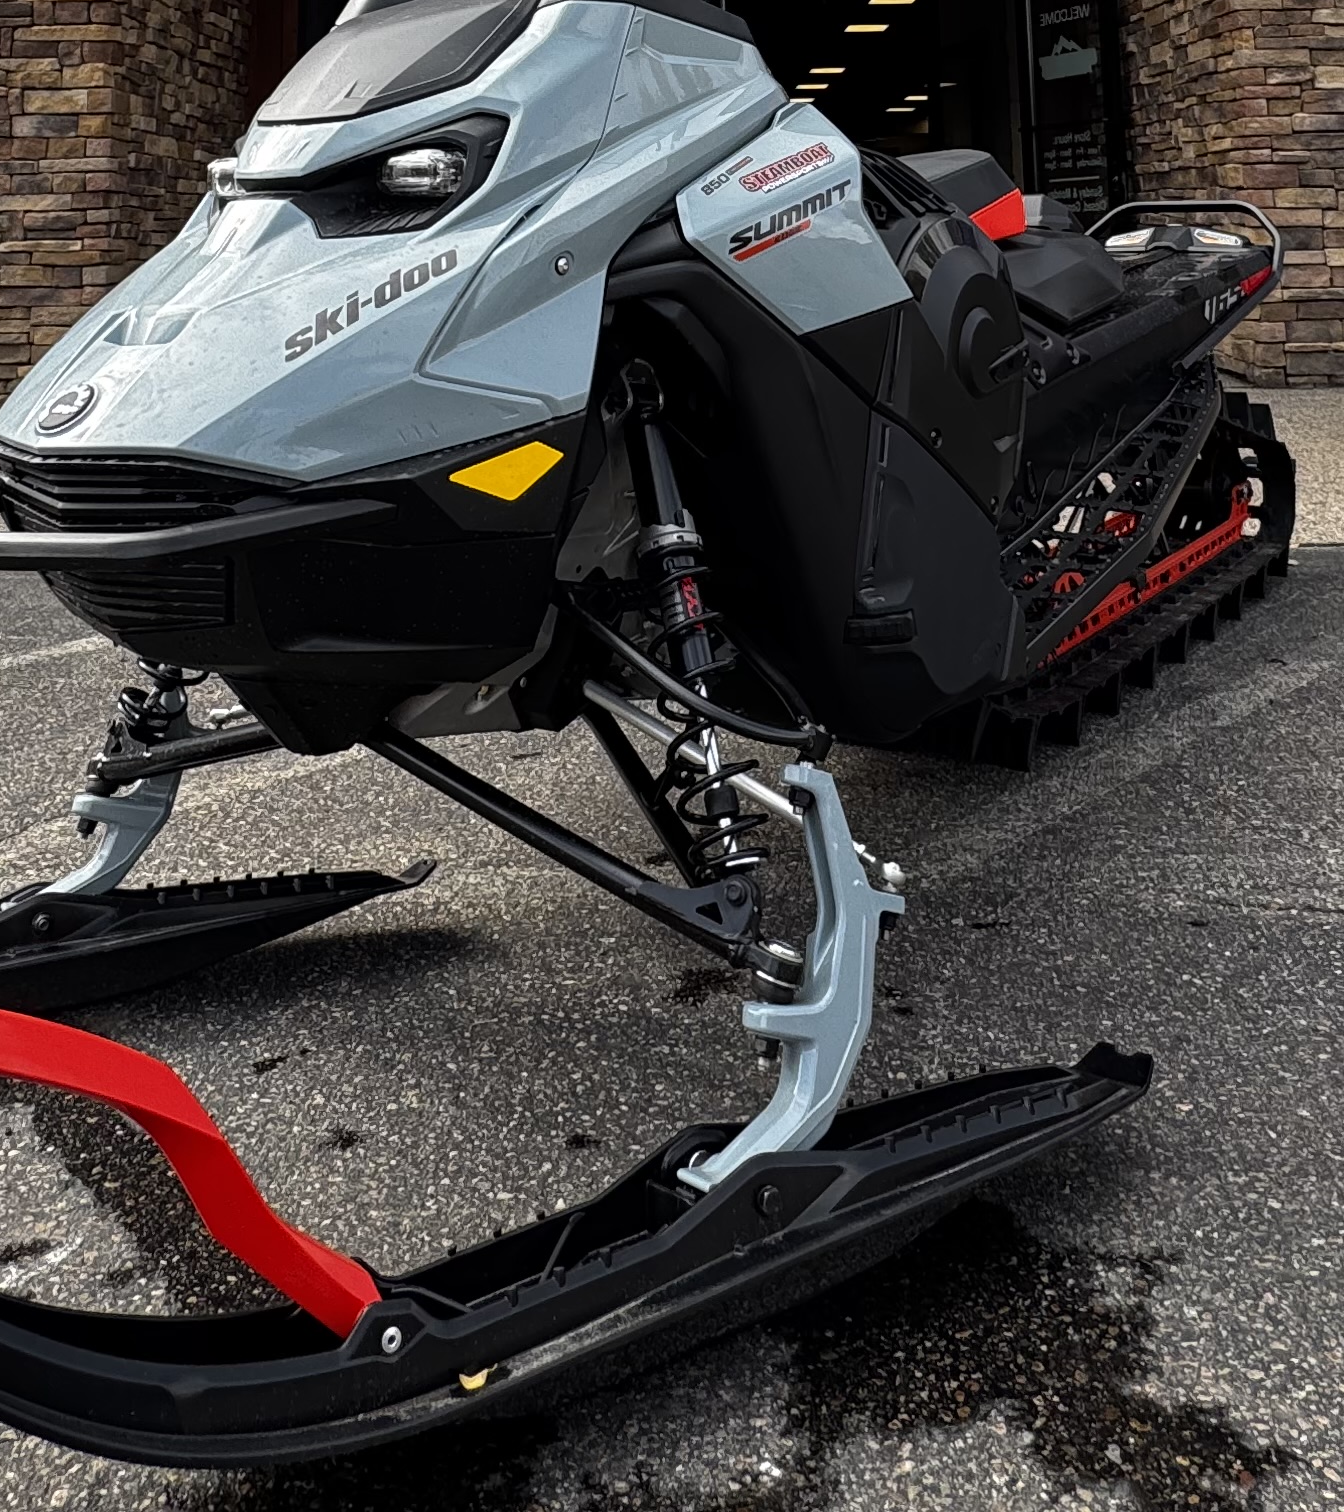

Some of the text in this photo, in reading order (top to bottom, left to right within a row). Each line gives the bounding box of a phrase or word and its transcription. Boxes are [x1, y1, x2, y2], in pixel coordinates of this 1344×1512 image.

[701, 173, 731, 196] 850
[742, 144, 830, 190] STEAMBOAT
[728, 179, 851, 255] SUMMIT
[284, 248, 458, 363] ski-doo
